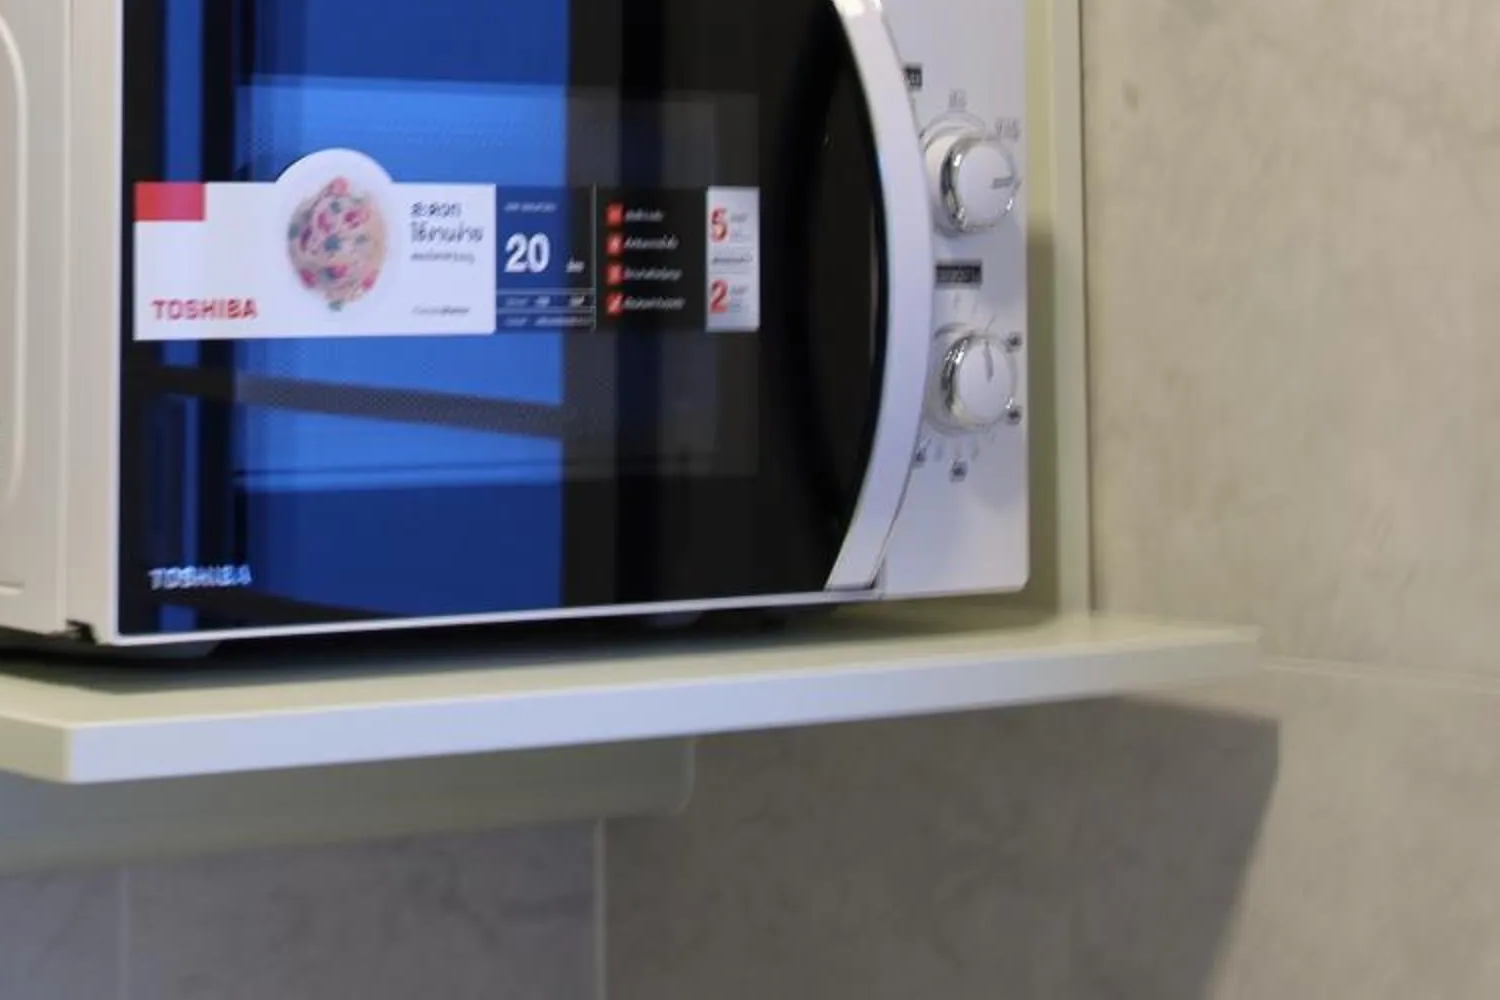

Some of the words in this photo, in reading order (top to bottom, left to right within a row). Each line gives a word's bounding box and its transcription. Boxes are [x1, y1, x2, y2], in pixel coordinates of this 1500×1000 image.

[710, 207, 729, 242] 5
[504, 232, 550, 273] 20
[152, 299, 257, 319] TOSHIBA
[710, 280, 729, 313] 2
[148, 565, 251, 590] TOSHIBA
